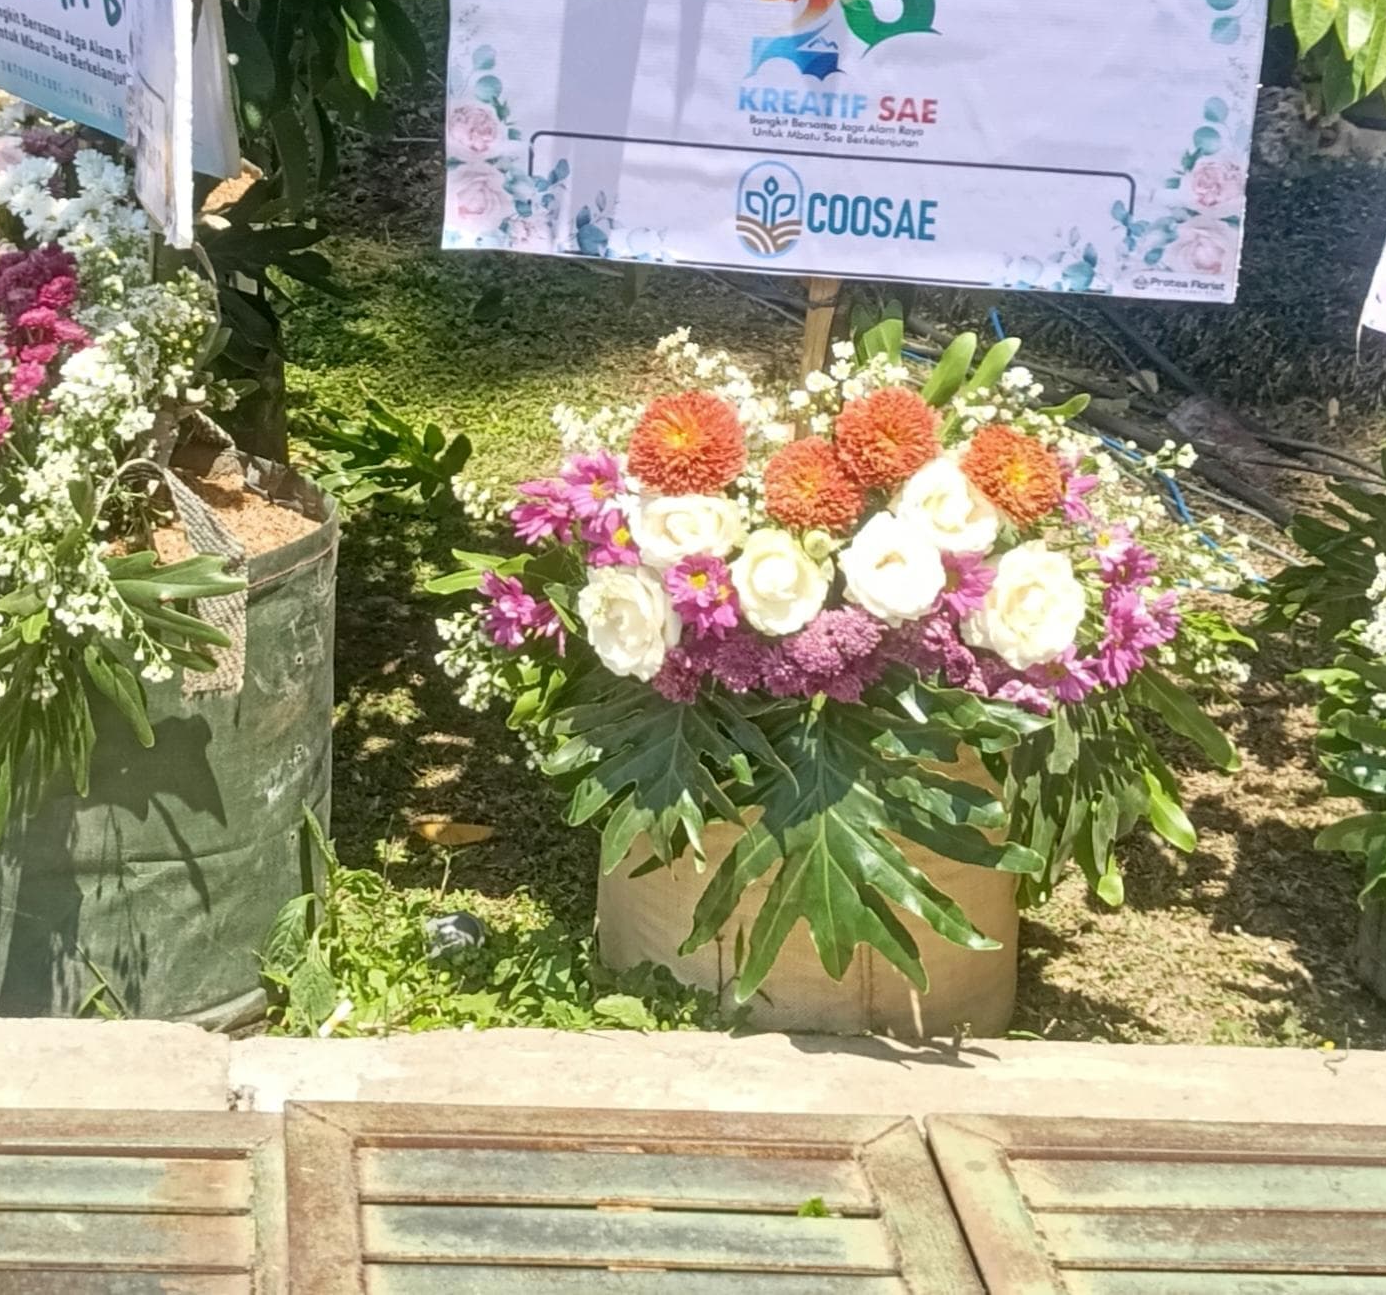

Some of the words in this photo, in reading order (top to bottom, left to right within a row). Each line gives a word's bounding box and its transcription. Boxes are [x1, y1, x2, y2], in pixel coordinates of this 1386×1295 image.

[20, 33, 51, 57] Mbatu
[51, 45, 69, 64] Sae
[21, 13, 62, 40] Bersama
[64, 29, 87, 52] Jaga
[89, 39, 114, 60] Alam
[738, 86, 868, 119] KREATIF
[878, 96, 938, 124] SAE
[749, 114, 788, 129] Bangkit
[791, 118, 838, 131] Bersama
[841, 122, 865, 135] Jaga
[867, 124, 896, 135] Alam
[899, 126, 925, 137] Raya
[752, 127, 784, 139] Untuk
[787, 130, 821, 143] Mbatu
[823, 133, 843, 143] Sae
[846, 135, 919, 148] Berkelanjutan
[807, 192, 939, 241] COOSAE
